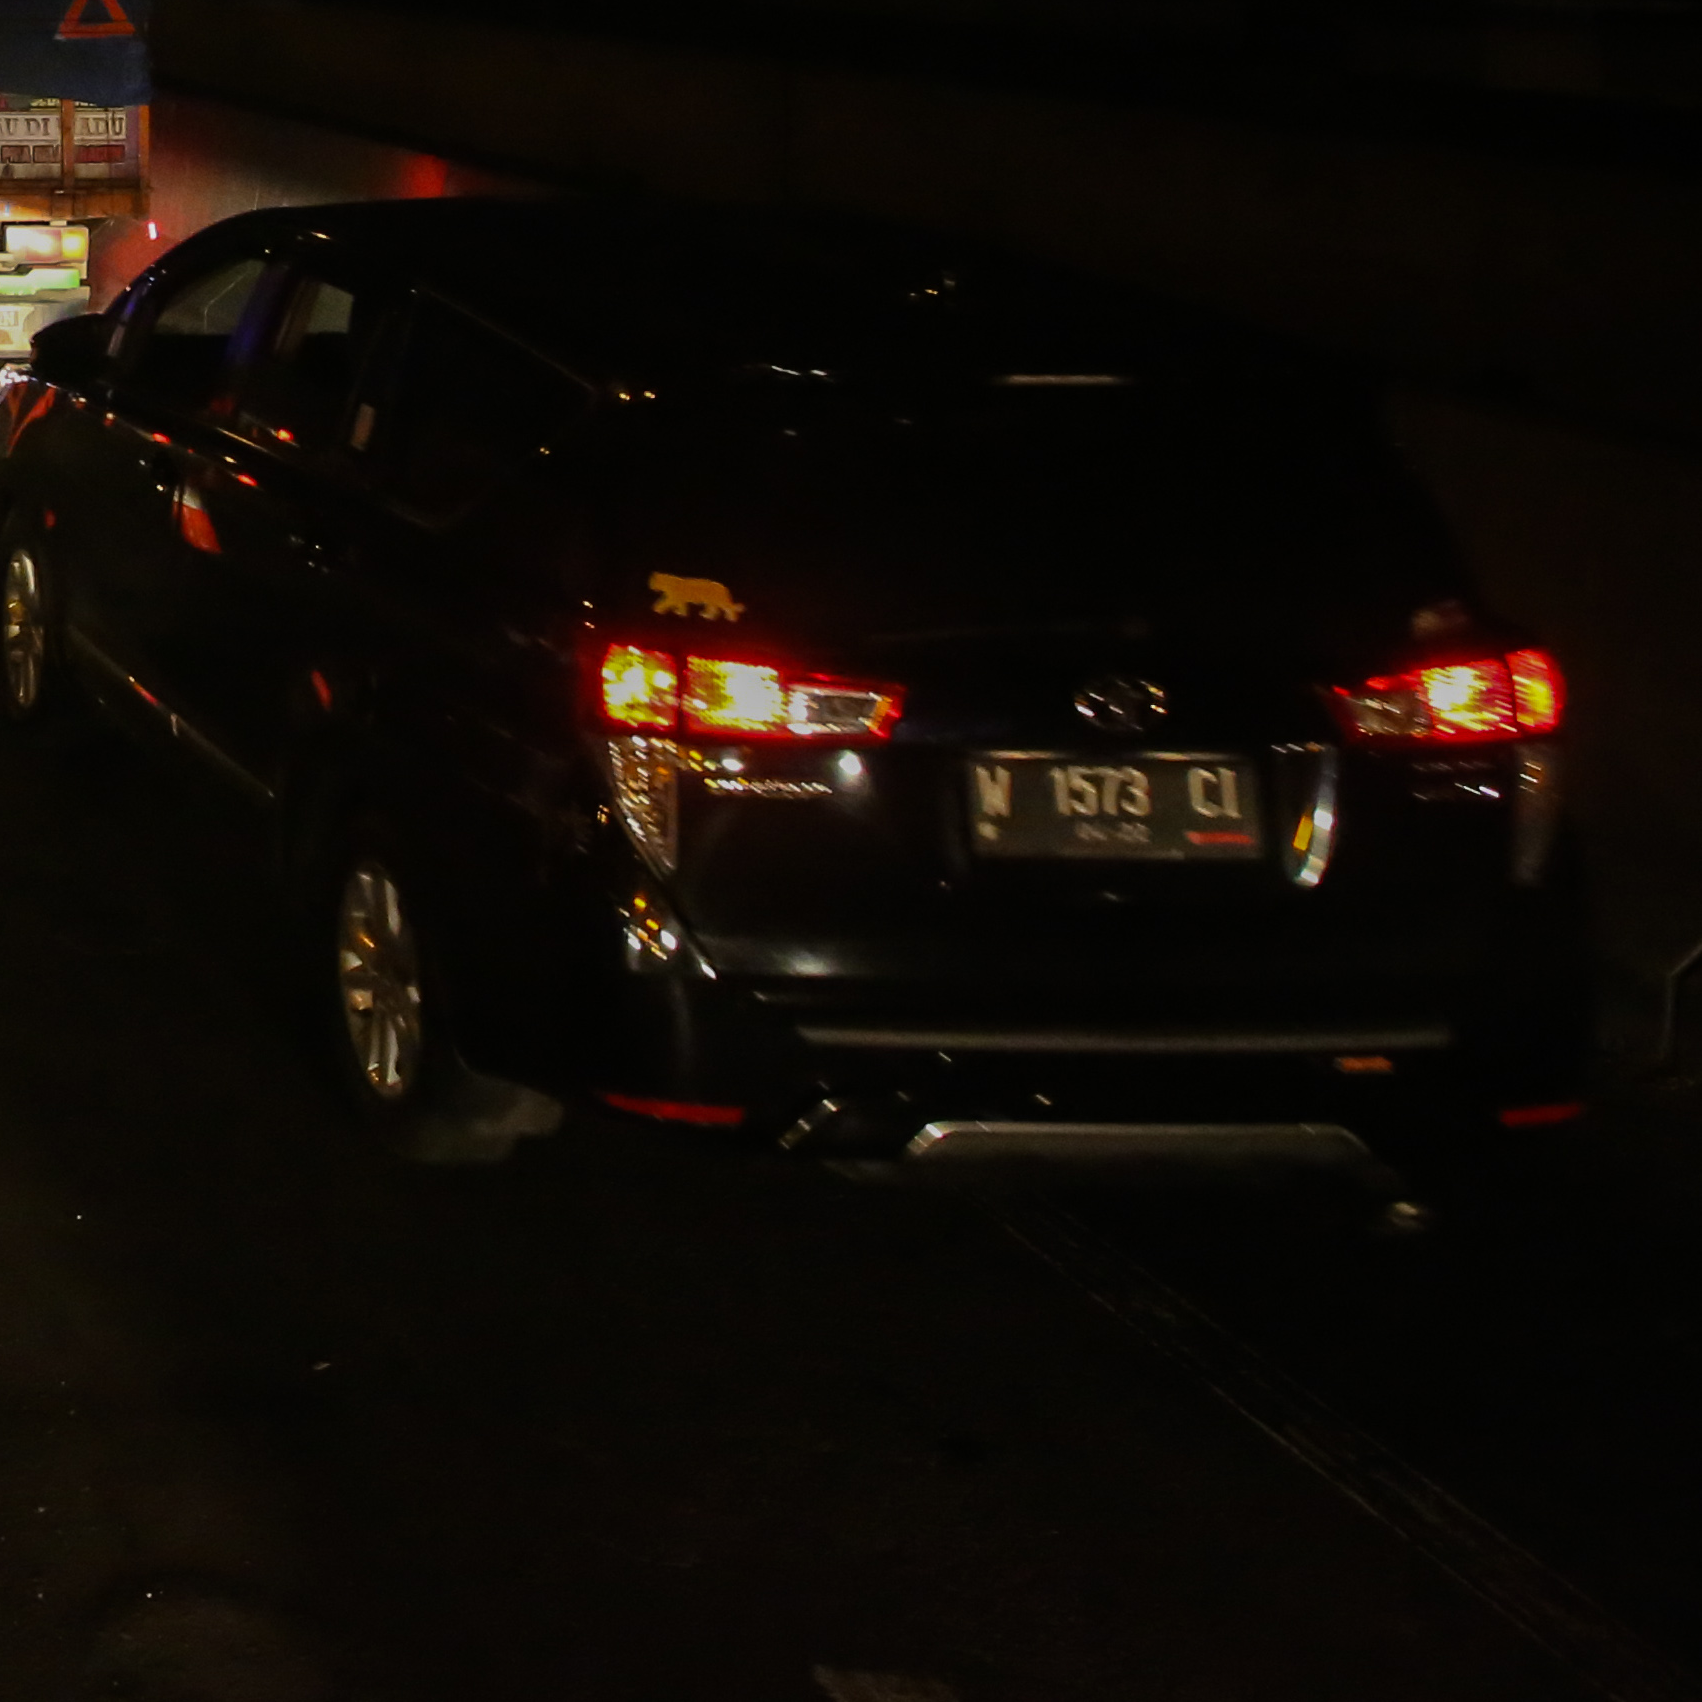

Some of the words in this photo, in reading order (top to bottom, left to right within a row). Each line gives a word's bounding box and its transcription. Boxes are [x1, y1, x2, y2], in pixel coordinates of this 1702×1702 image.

[25, 117, 50, 137] DI
[57, 116, 124, 136] ADU
[1050, 764, 1152, 817] 1573
